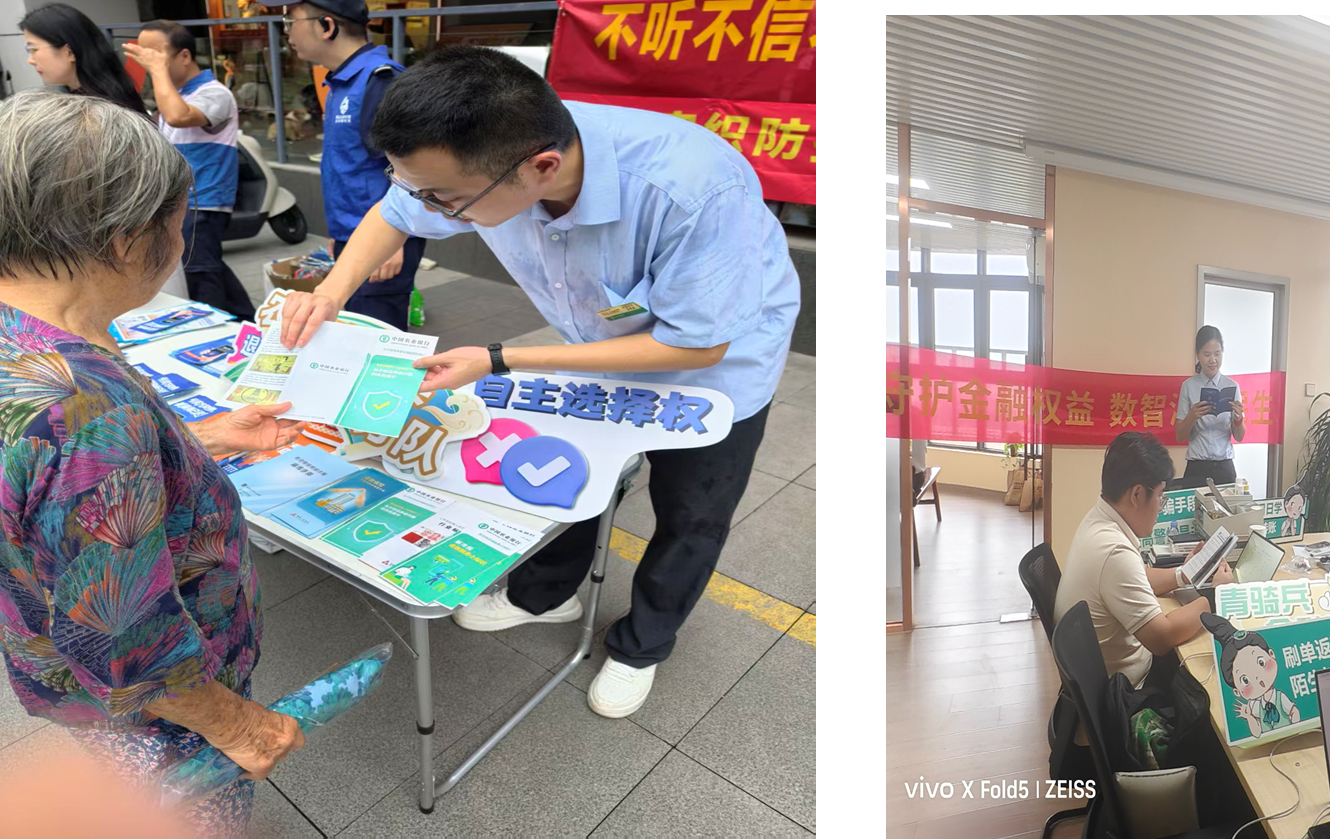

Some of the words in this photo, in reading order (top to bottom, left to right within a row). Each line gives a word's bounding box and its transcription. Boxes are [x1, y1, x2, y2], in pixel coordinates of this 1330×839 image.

[594, 0, 816, 62] 不听不信
[665, 111, 816, 163] 织防
[475, 374, 713, 435] 自主选择权
[886, 369, 1094, 427] 守护金融权益
[1260, 501, 1282, 516] 日学
[1220, 583, 1312, 618] 青骑兵
